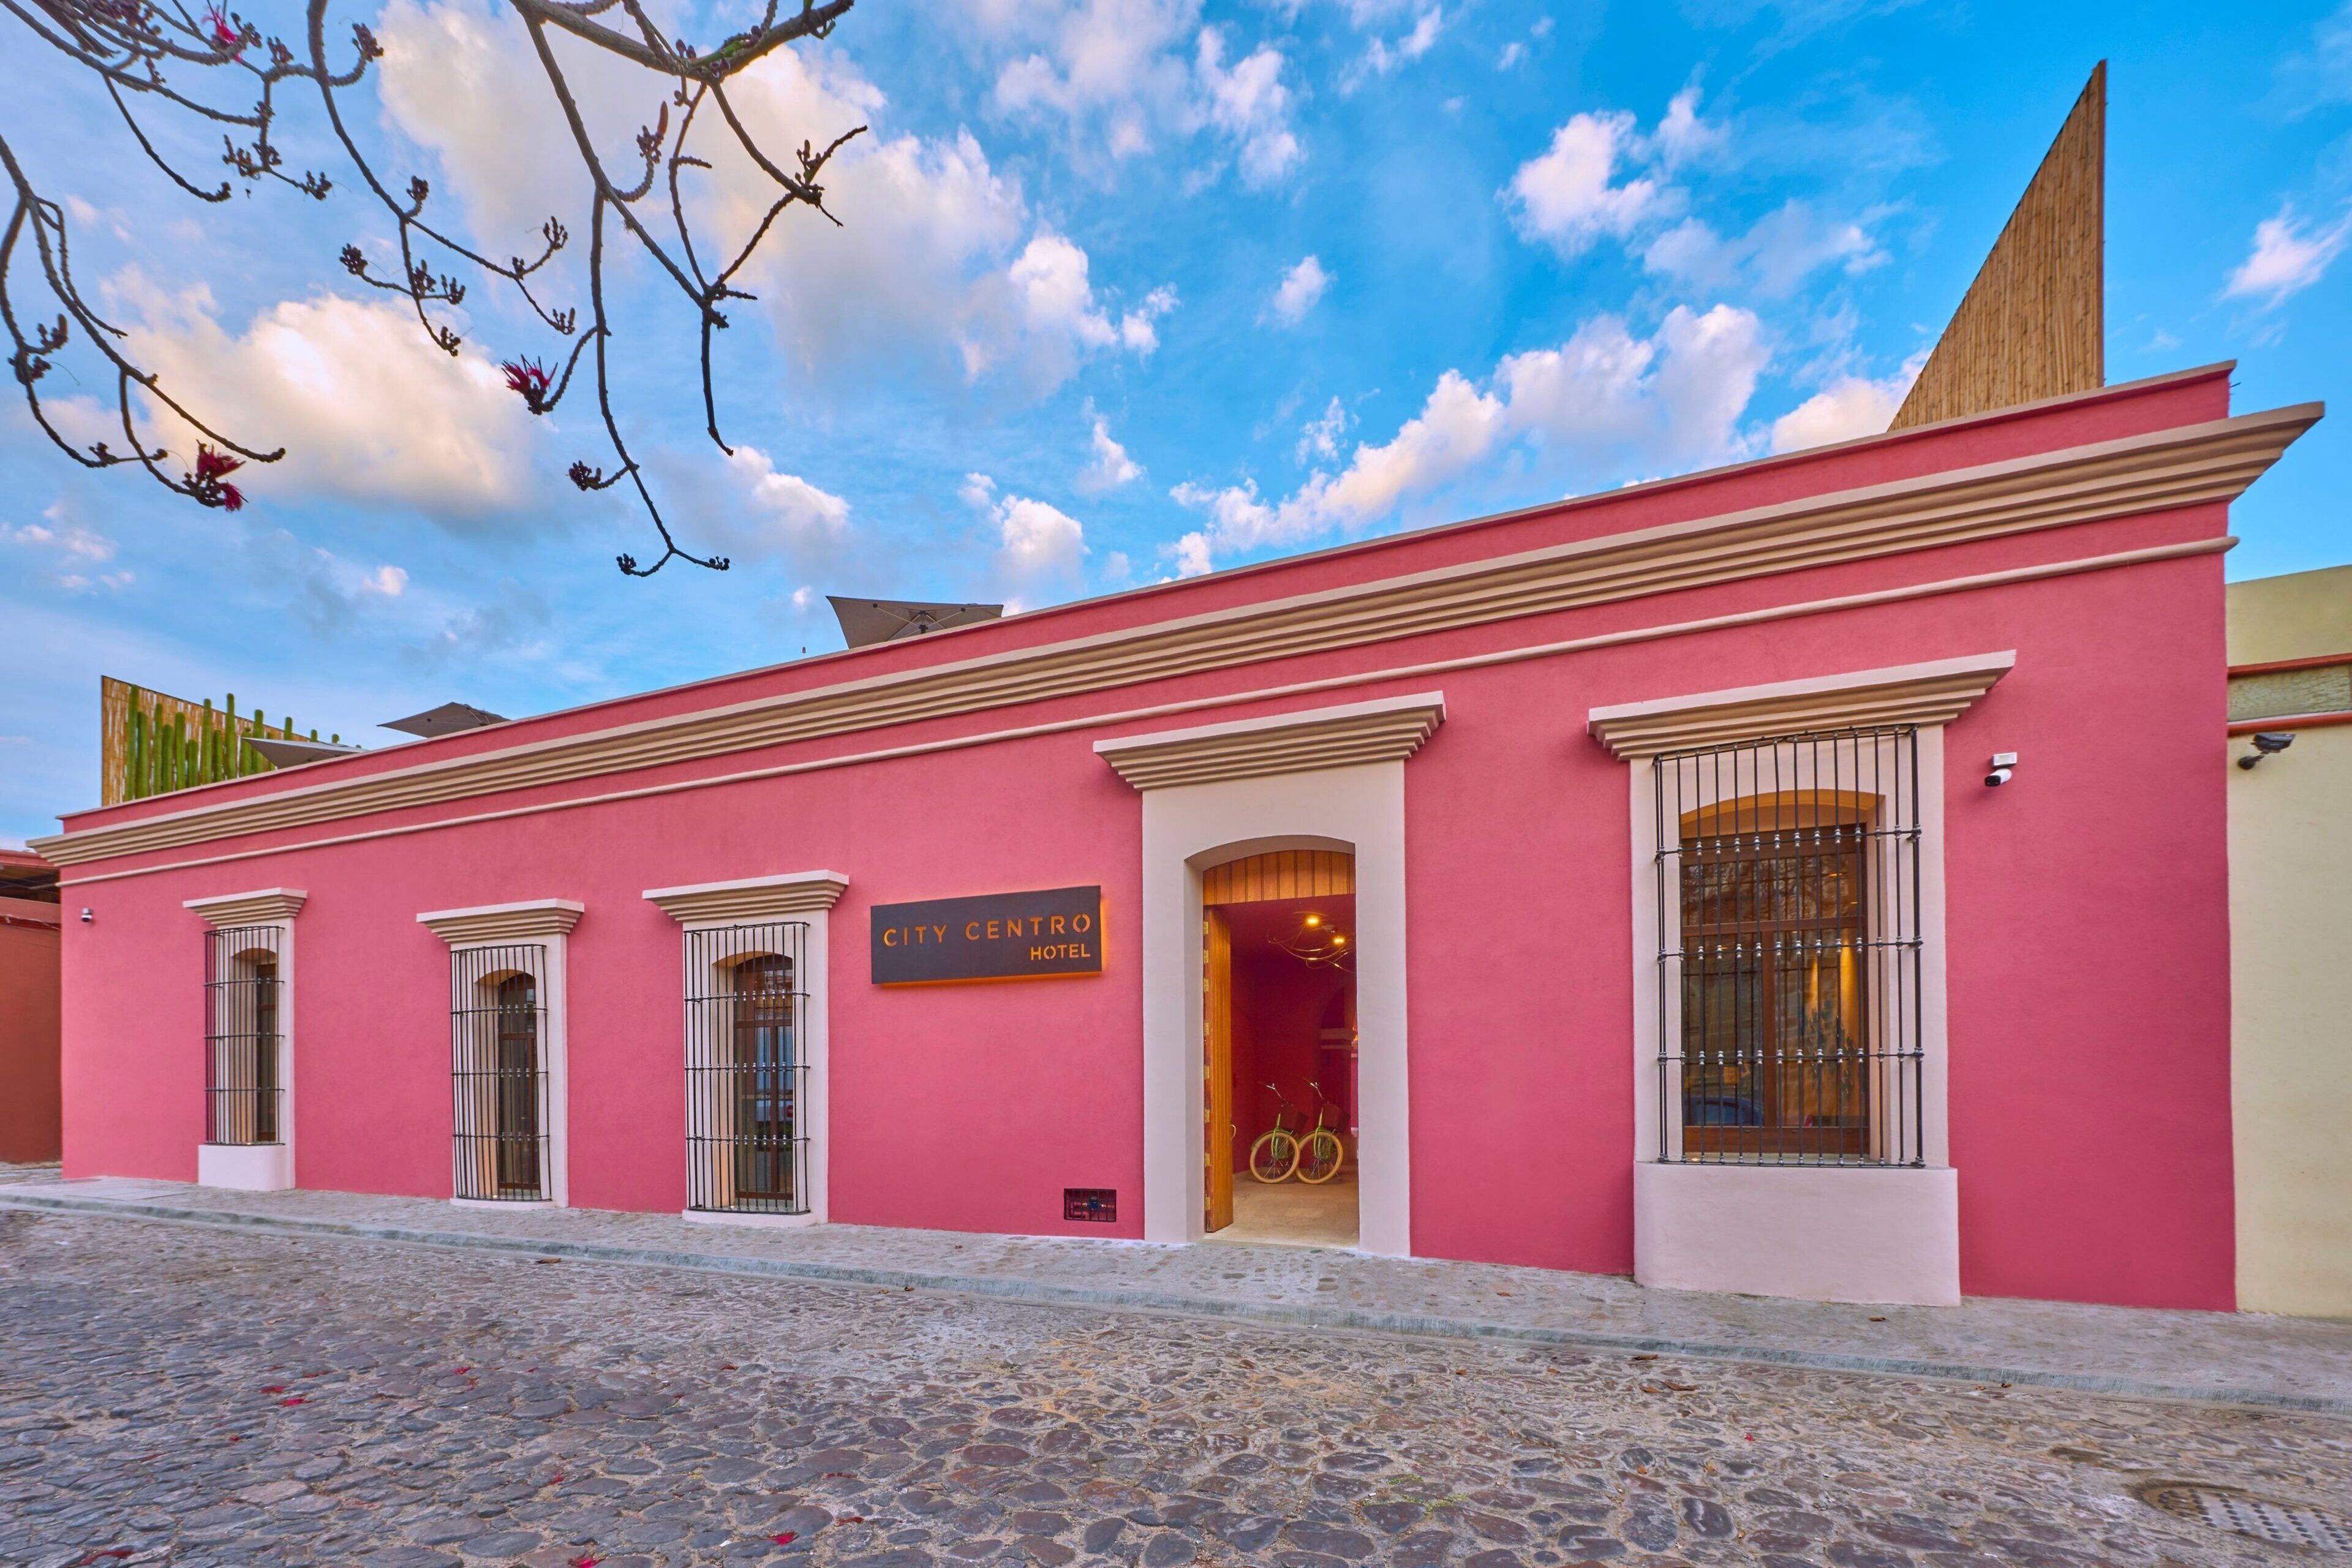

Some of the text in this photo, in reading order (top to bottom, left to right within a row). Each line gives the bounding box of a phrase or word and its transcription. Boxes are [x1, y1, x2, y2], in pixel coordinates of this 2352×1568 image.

[883, 913, 1091, 947] CITY CENTRO
[1030, 943, 1091, 960] HOTEL
